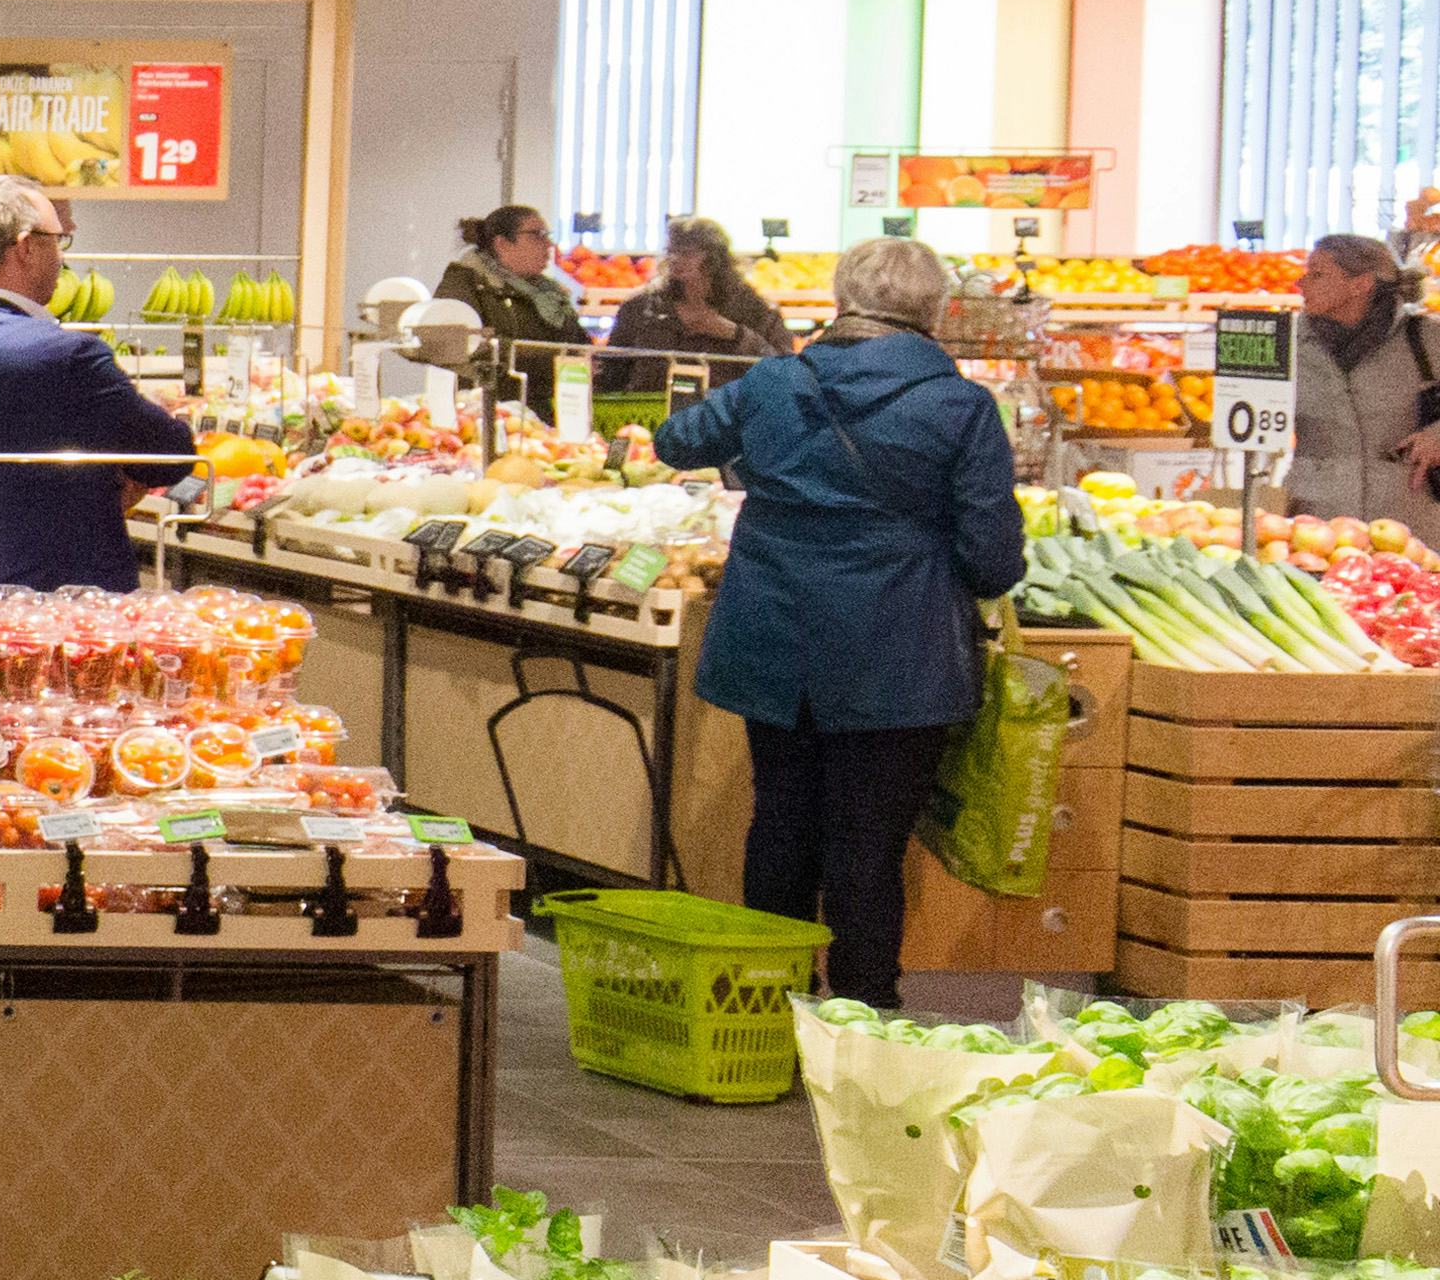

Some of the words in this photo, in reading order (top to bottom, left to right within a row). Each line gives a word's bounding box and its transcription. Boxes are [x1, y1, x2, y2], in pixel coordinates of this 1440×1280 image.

[40, 95, 109, 133] TRADE
[135, 132, 197, 180] 1.29
[1228, 401, 1286, 444] 0.89
